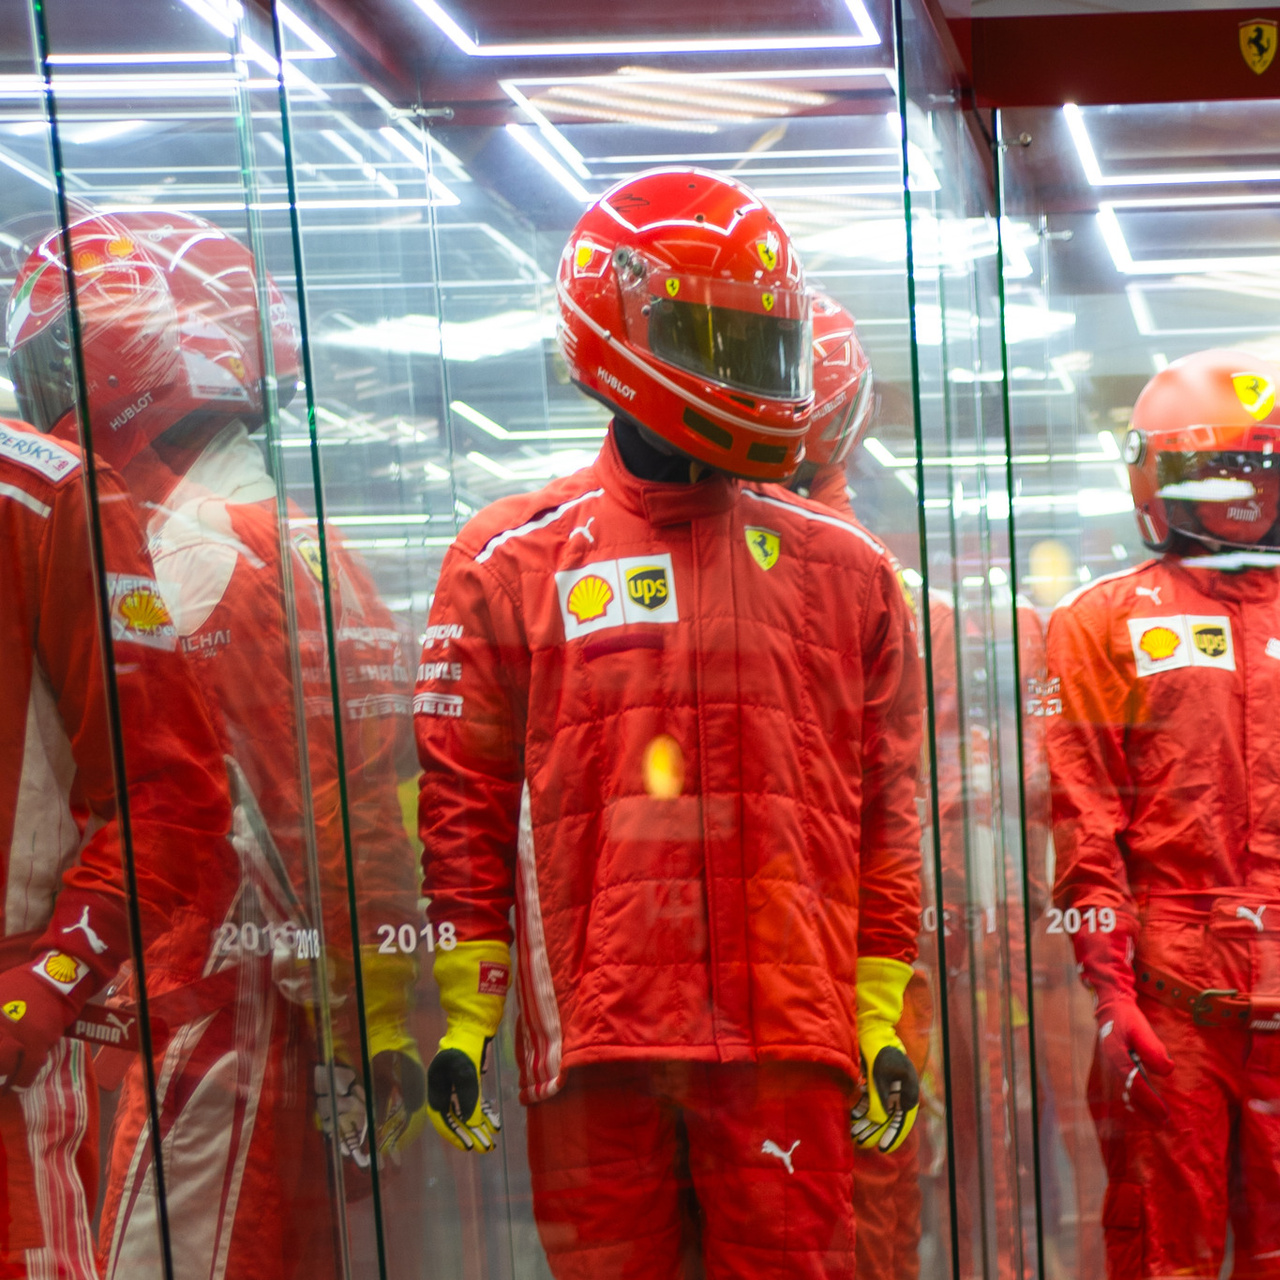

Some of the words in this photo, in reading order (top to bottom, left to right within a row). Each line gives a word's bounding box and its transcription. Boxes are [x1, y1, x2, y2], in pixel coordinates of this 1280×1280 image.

[597, 366, 636, 401] HUBLOT
[109, 391, 154, 432] HUBLOT
[628, 578, 667, 605] ups
[181, 629, 231, 653] ICHAI
[1045, 907, 1117, 934] 2019
[377, 921, 457, 953] 2018
[76, 1020, 121, 1044] PUMA
